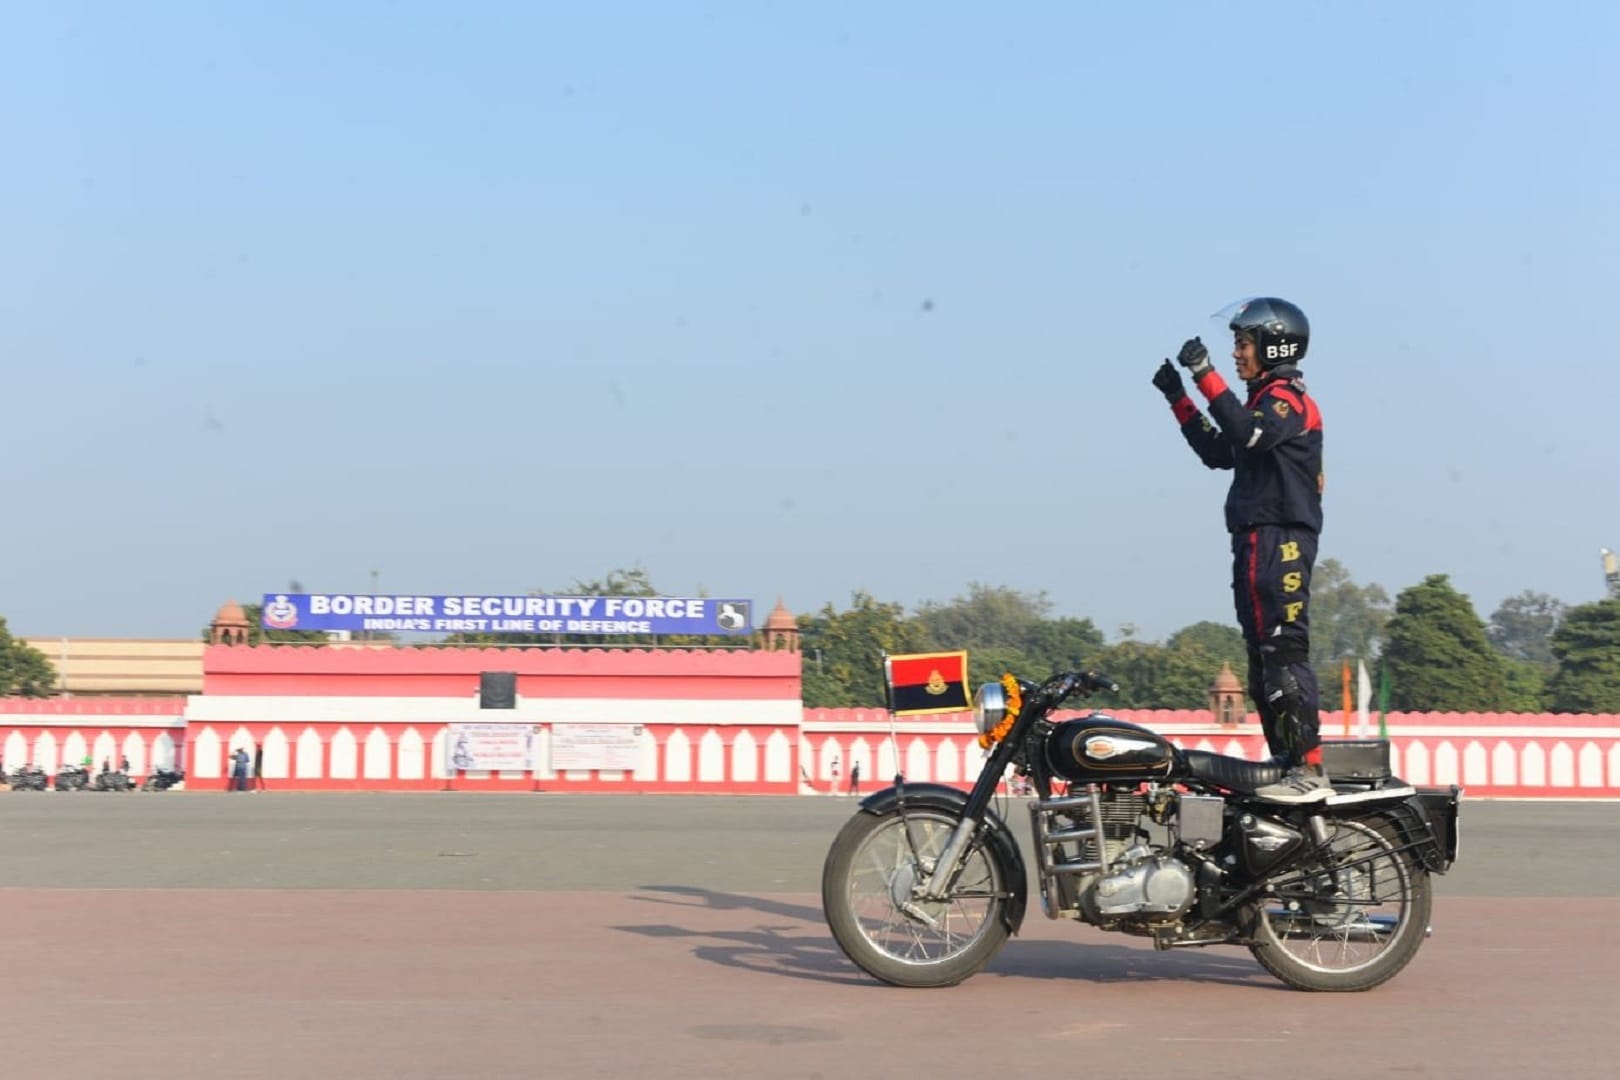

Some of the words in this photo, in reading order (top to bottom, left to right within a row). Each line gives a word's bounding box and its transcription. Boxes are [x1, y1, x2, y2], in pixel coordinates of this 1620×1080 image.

[1266, 343, 1298, 359] BSF
[309, 595, 436, 615] BORDER
[443, 597, 597, 617] SECURITY
[605, 600, 705, 618] FORCE
[363, 618, 432, 630] INDIA'S
[434, 619, 488, 631] FIRST
[492, 619, 535, 631] LINE
[538, 620, 563, 631] OF
[567, 620, 651, 633] DEFENCE
